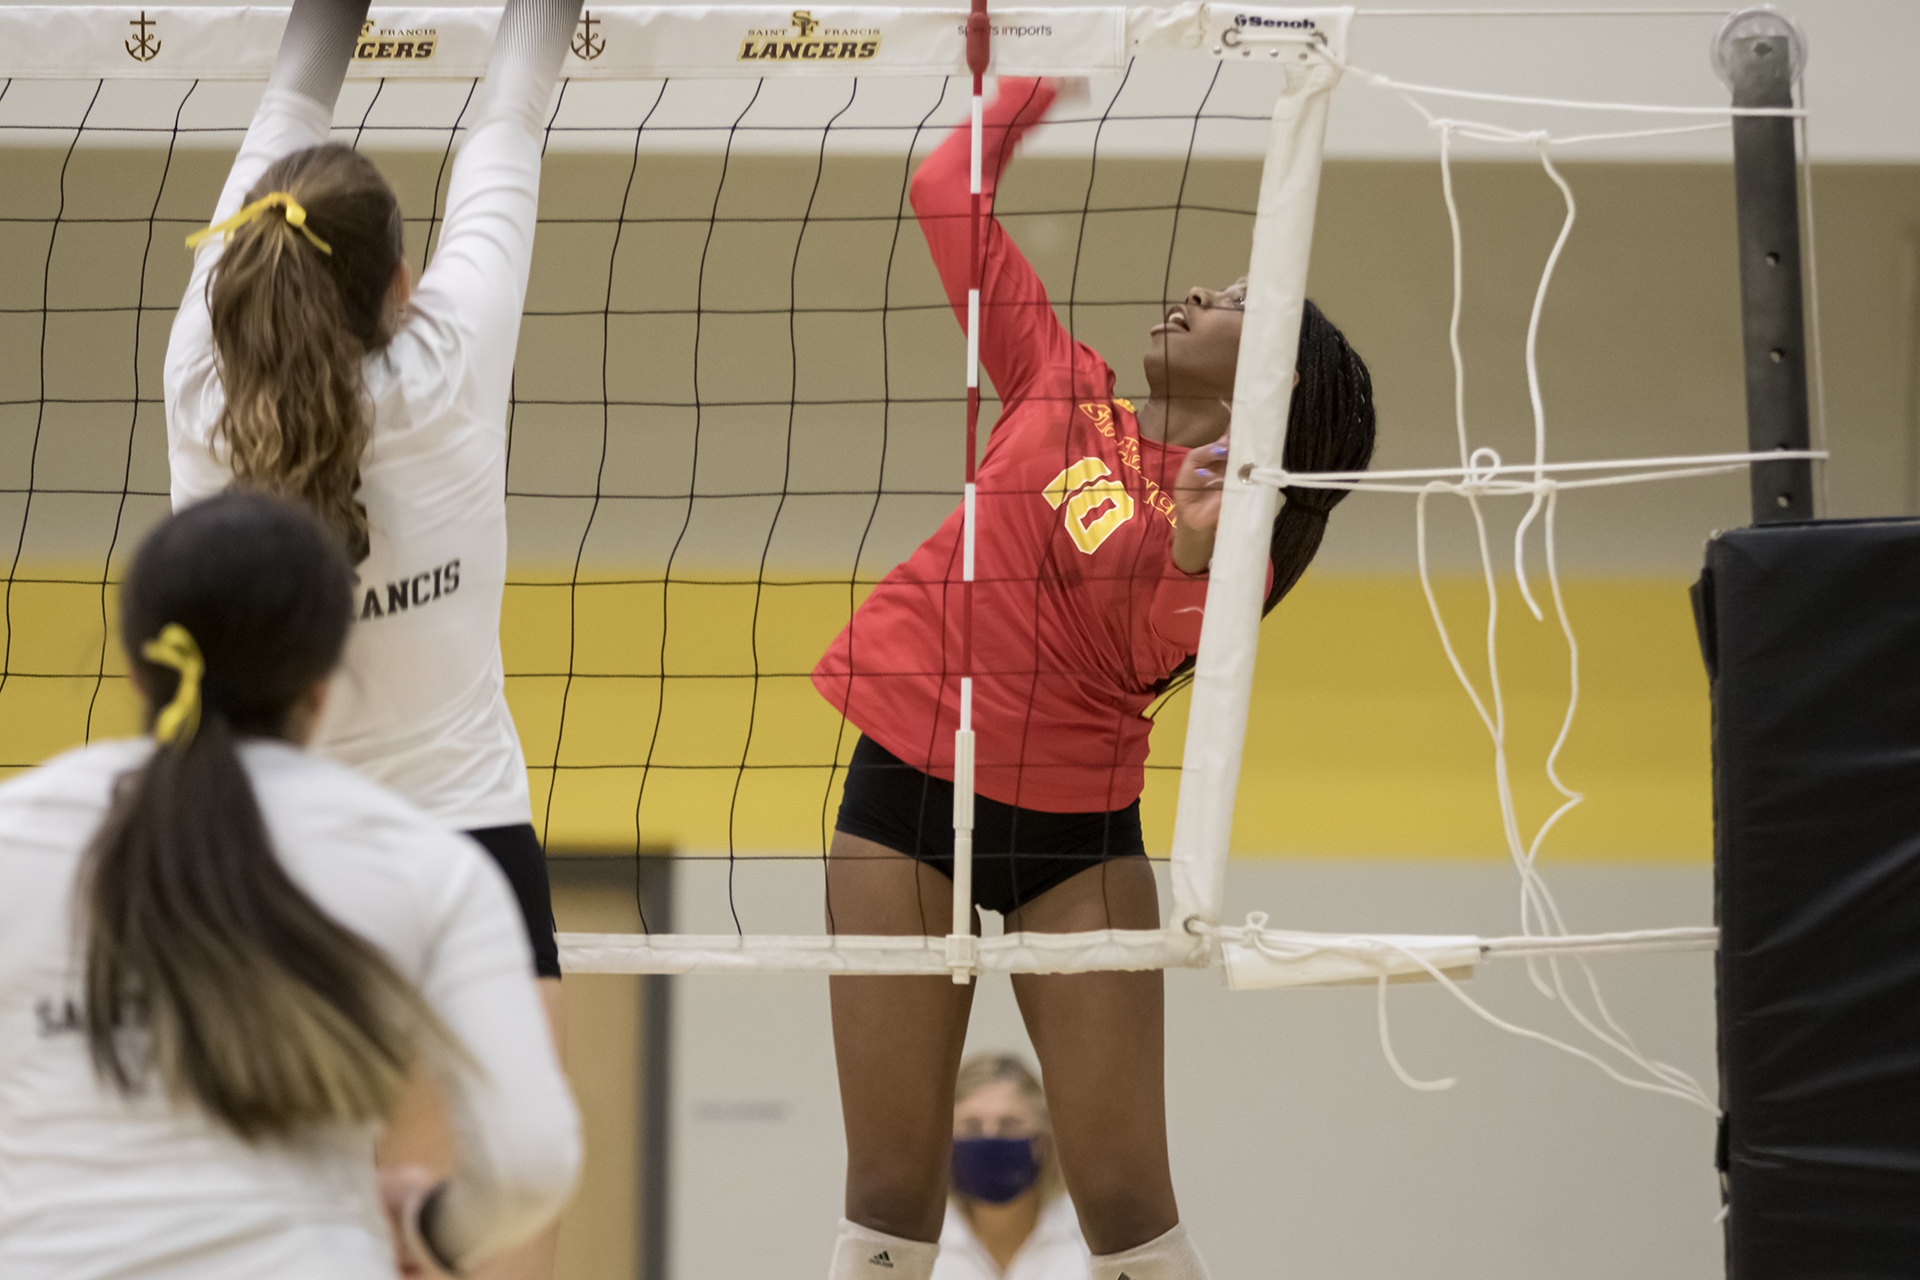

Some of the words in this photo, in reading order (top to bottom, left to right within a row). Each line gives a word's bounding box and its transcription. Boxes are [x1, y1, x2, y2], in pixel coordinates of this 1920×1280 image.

[380, 28, 437, 36] FRANCIS
[825, 28, 880, 36] FRANCIS
[1002, 25, 1052, 38] imports
[353, 41, 434, 59] CERS
[740, 42, 877, 59] LANCERS
[1042, 457, 1134, 555] 10
[360, 559, 460, 620] ANCIS
